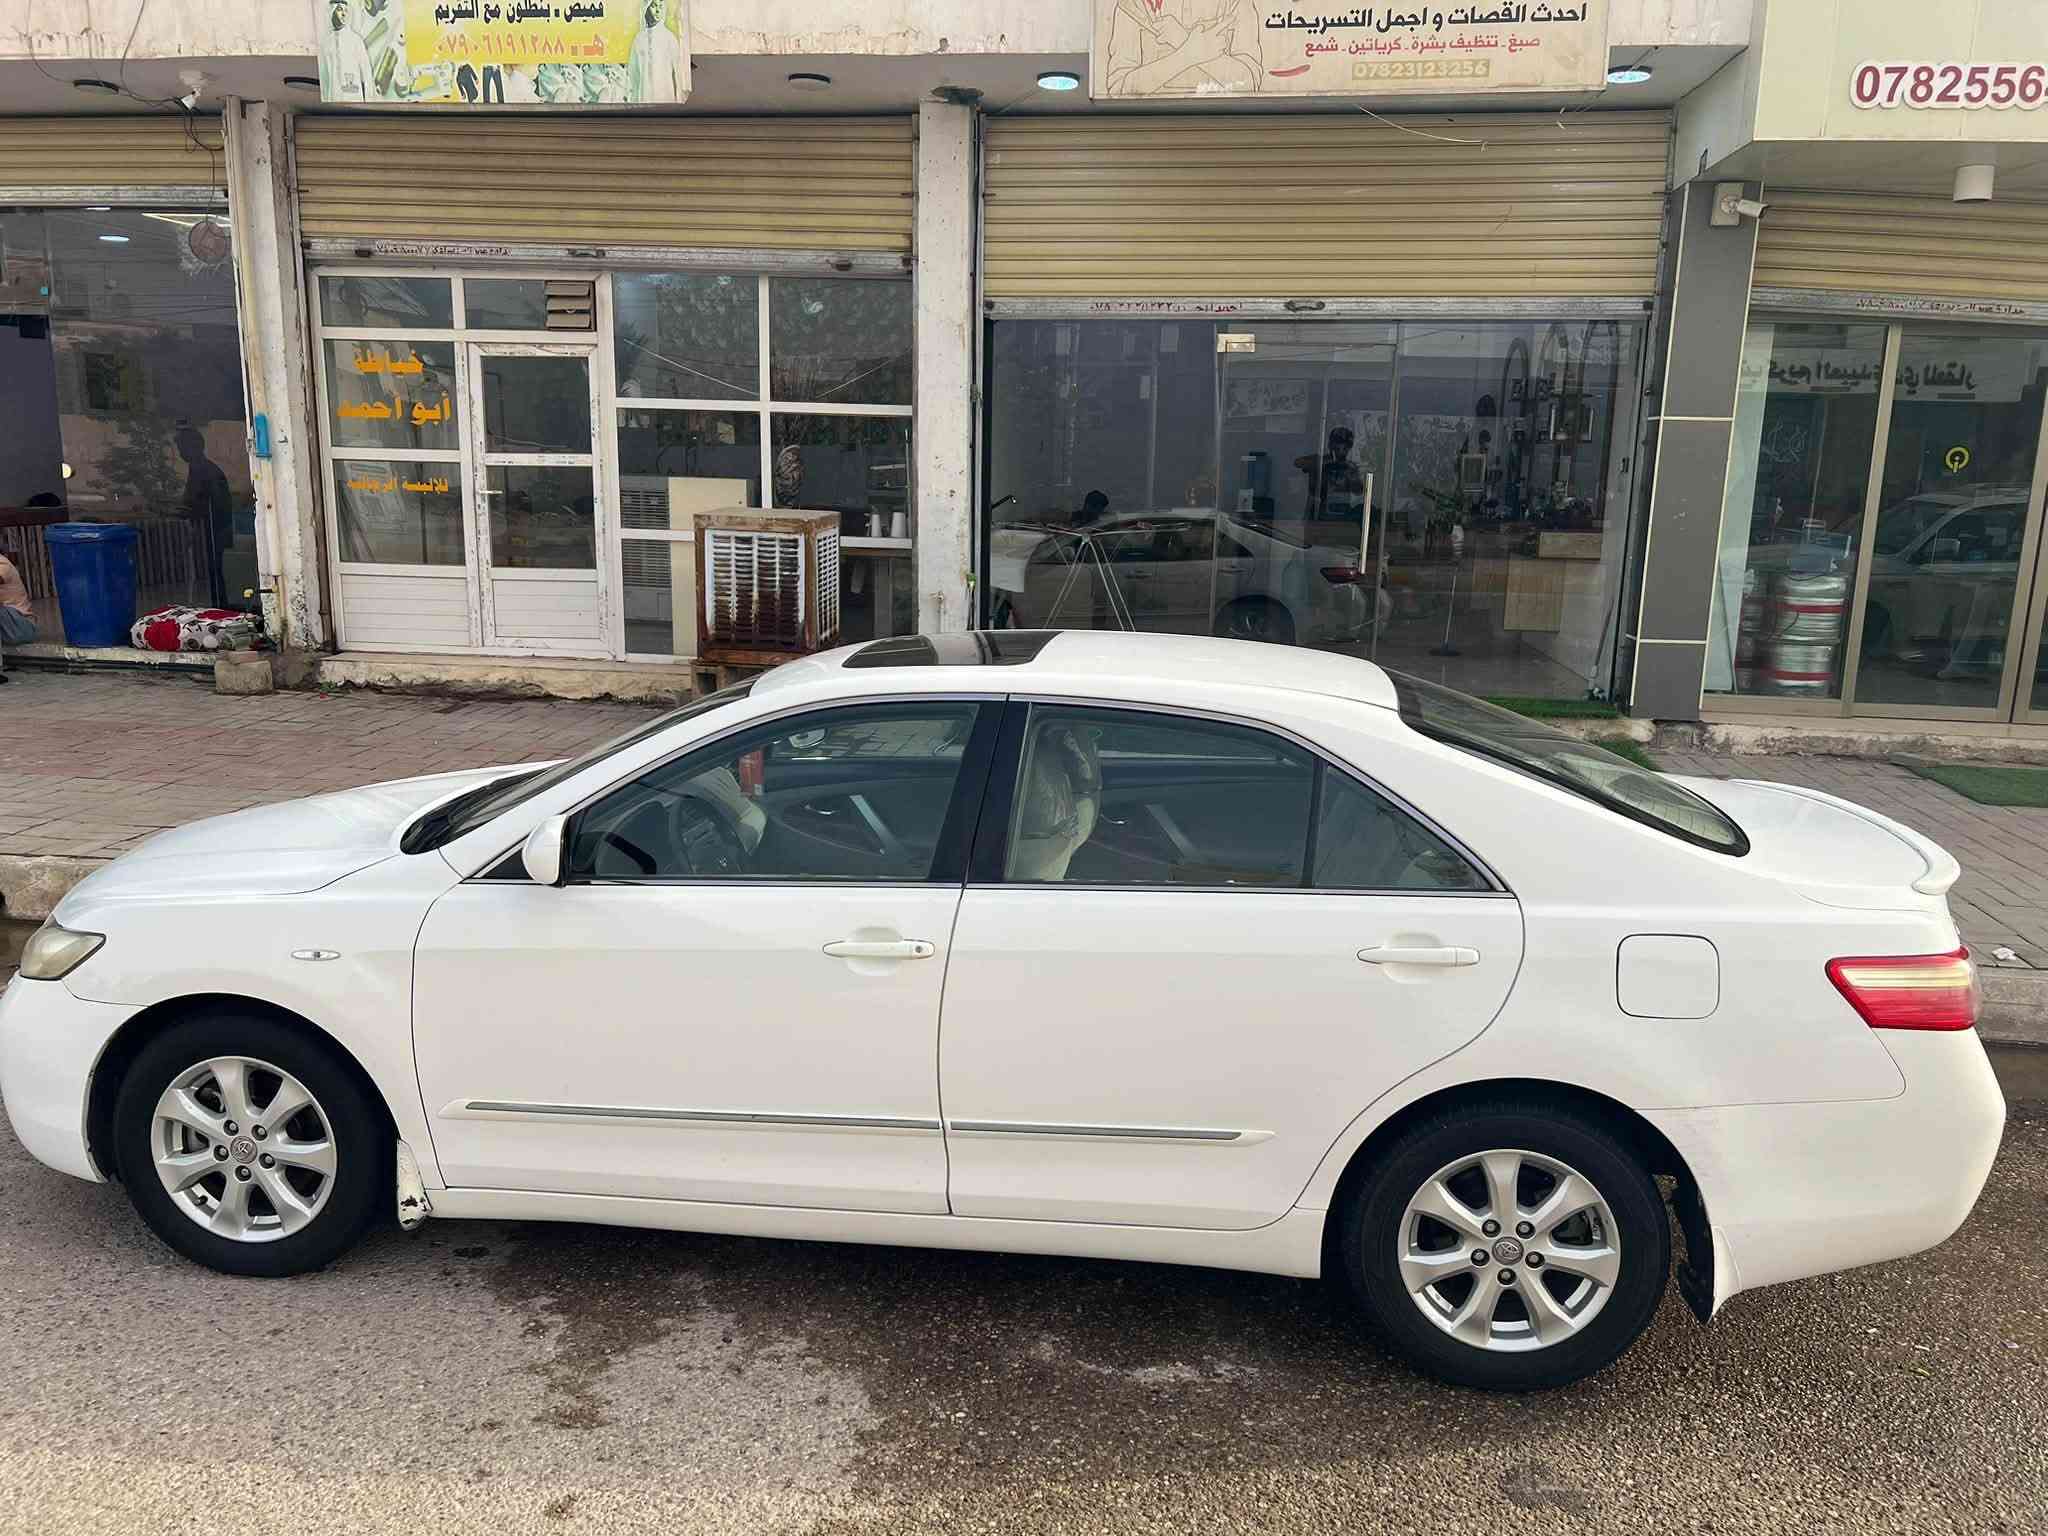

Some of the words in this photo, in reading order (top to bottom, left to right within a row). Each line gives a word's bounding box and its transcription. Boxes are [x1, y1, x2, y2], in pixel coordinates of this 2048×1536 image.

[483, 2, 502, 25] مع
[1265, 8, 1373, 35] التسريحات
[1375, 7, 1428, 33] اجمل
[1432, 12, 1444, 33] و
[1448, 1, 1527, 25] القصات
[1305, 37, 1339, 57] شمع
[1412, 35, 1447, 54] بشرة
[1449, 33, 1498, 53] تنظيف
[1507, 33, 1541, 53] صبغ
